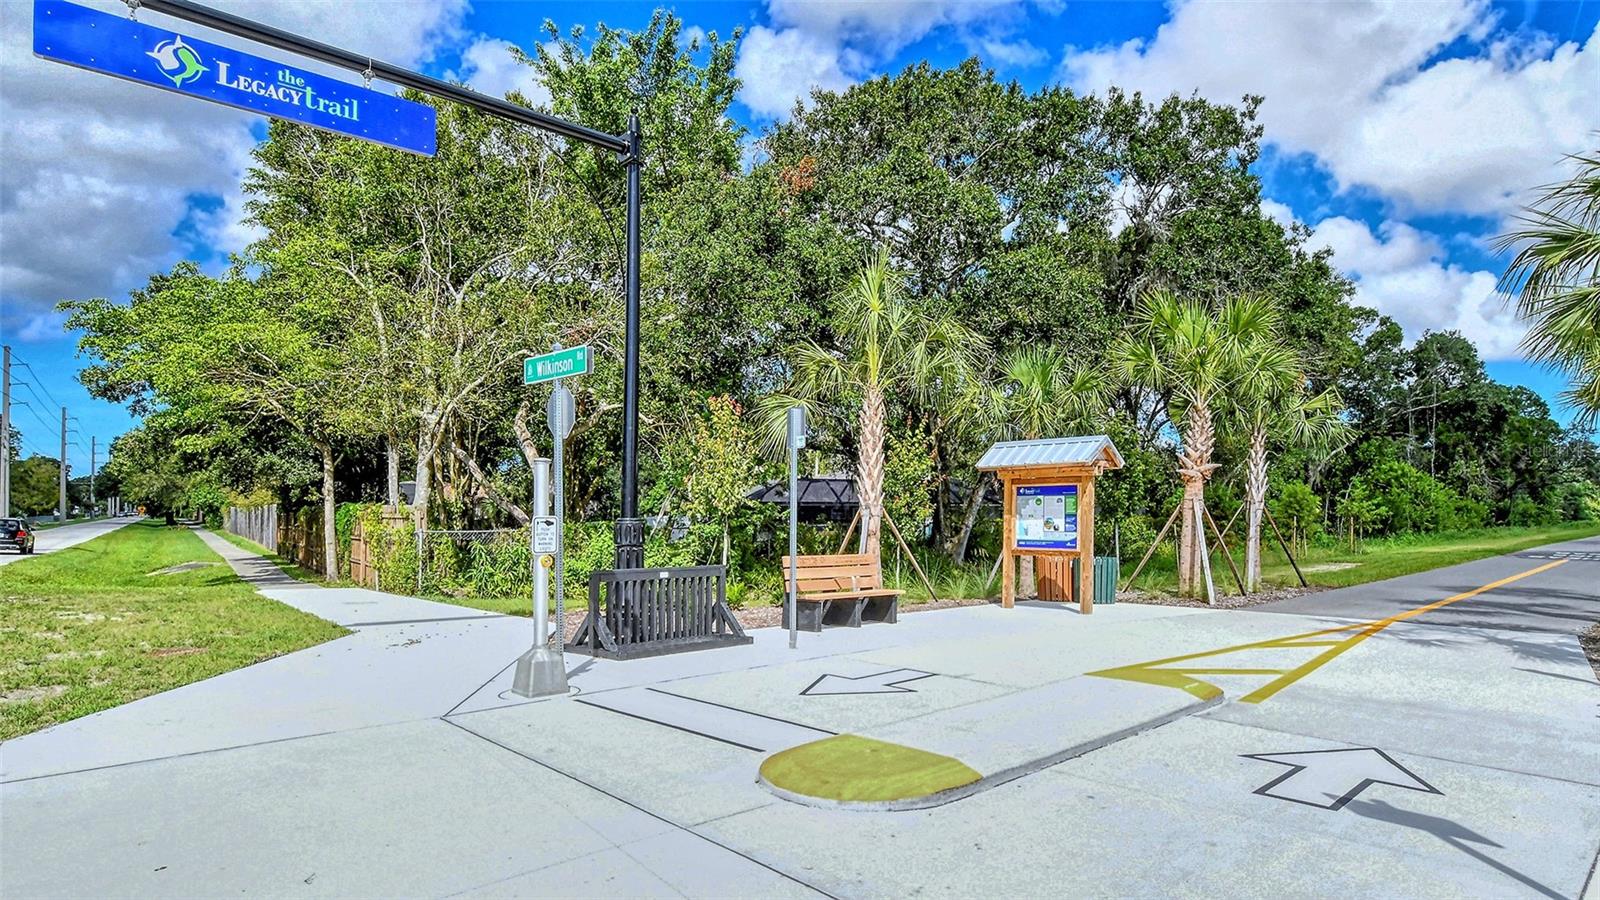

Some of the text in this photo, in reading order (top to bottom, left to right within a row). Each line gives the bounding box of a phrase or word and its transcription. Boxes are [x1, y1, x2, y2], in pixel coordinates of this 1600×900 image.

[216, 60, 360, 122] LEGACY trail
[277, 69, 304, 87] the
[536, 358, 573, 377] Wilkinson
[576, 350, 584, 361] Rd
